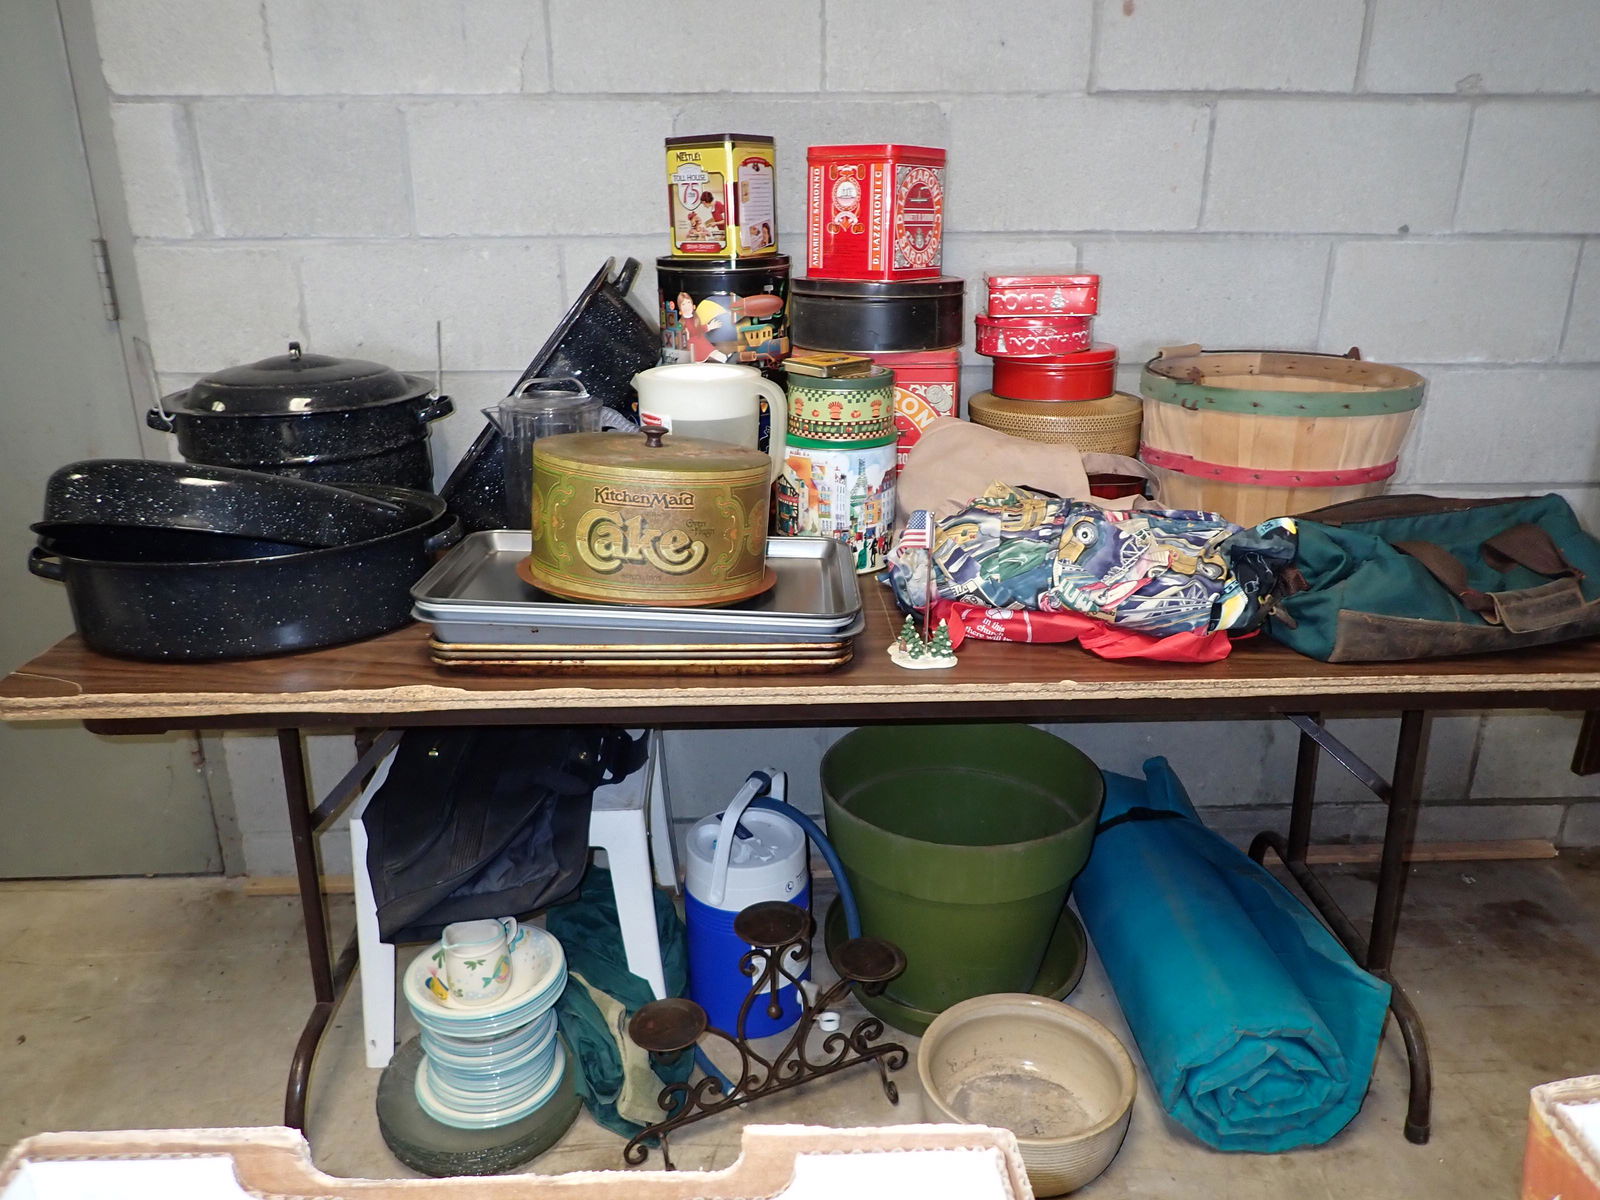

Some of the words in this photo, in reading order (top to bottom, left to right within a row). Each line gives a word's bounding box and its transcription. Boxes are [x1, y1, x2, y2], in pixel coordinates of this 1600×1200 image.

[681, 182, 700, 204] 75
[872, 188, 882, 251] LAZZARONI
[990, 293, 1046, 310] POLE
[575, 508, 710, 576] Cake
